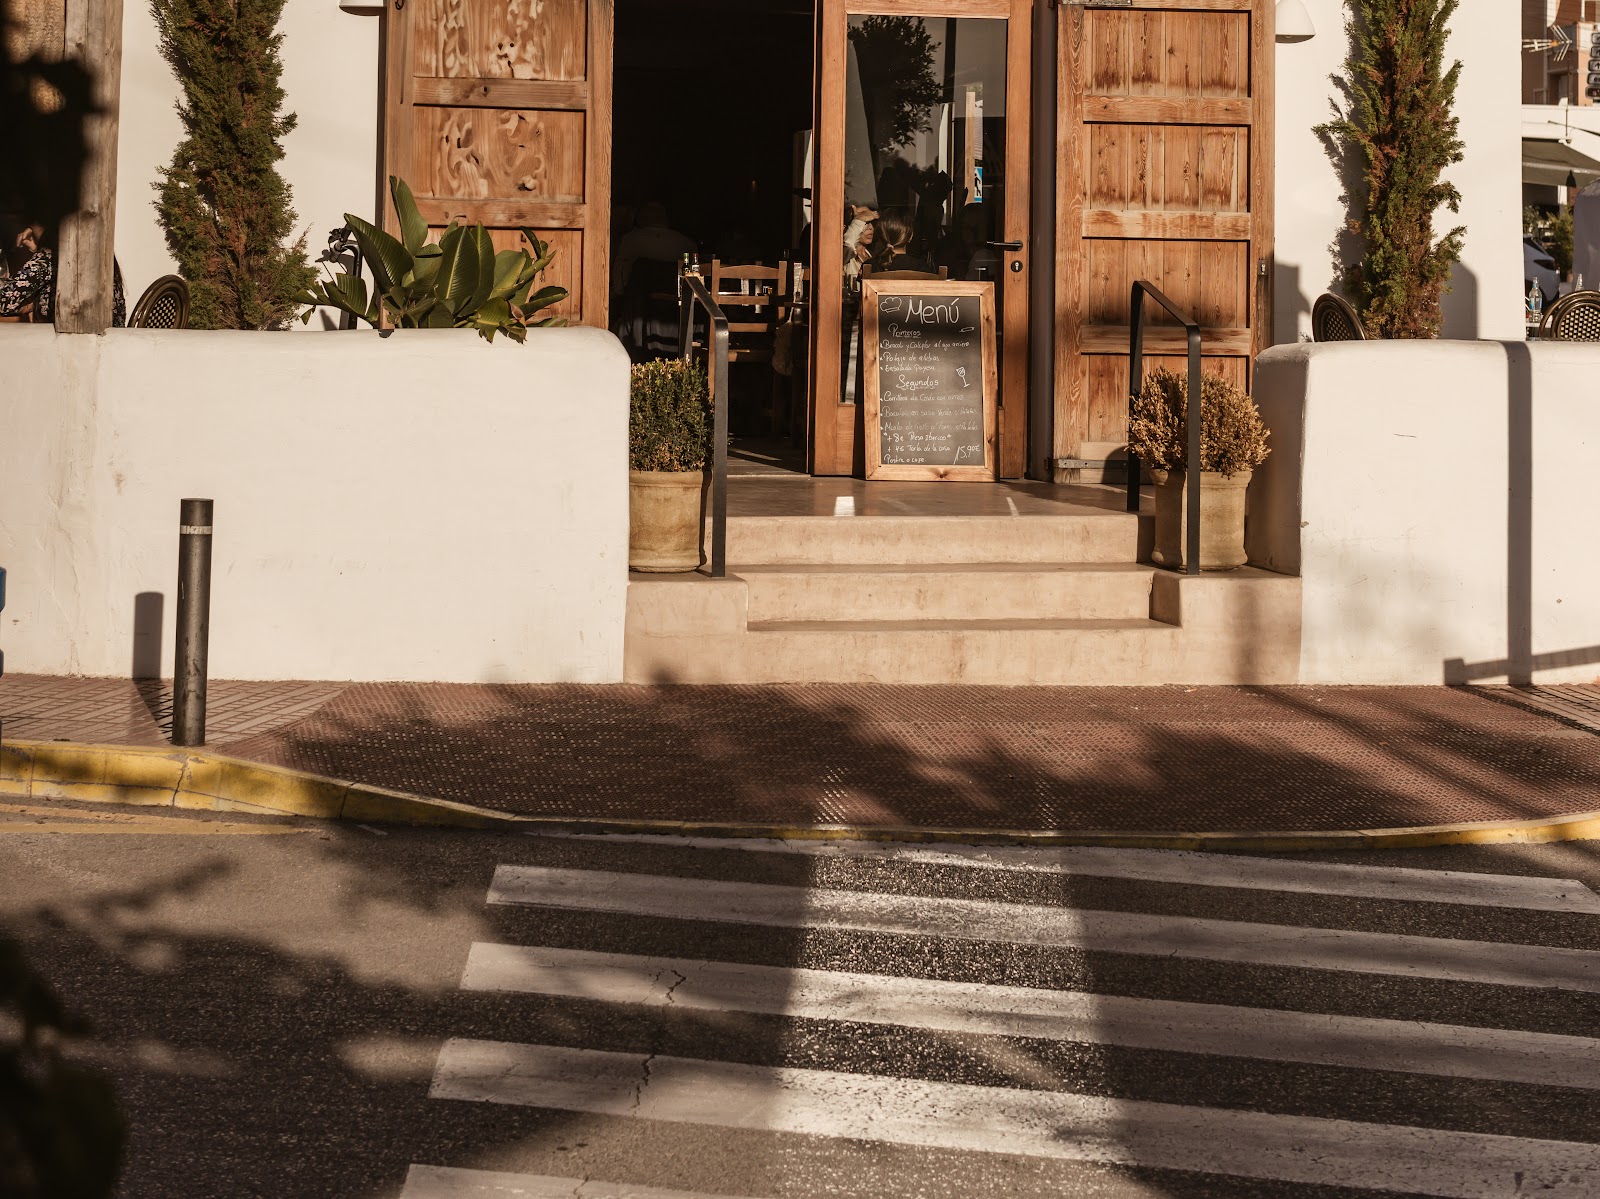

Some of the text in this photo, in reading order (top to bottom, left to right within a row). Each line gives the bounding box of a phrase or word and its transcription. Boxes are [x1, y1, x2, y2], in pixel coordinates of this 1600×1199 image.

[904, 297, 960, 325] Menú
[888, 322, 922, 338] Primeros
[908, 352, 917, 362] de
[895, 373, 939, 391] Segundos
[909, 392, 918, 401] de
[923, 443, 931, 452] de
[883, 453, 905, 465] Postre
